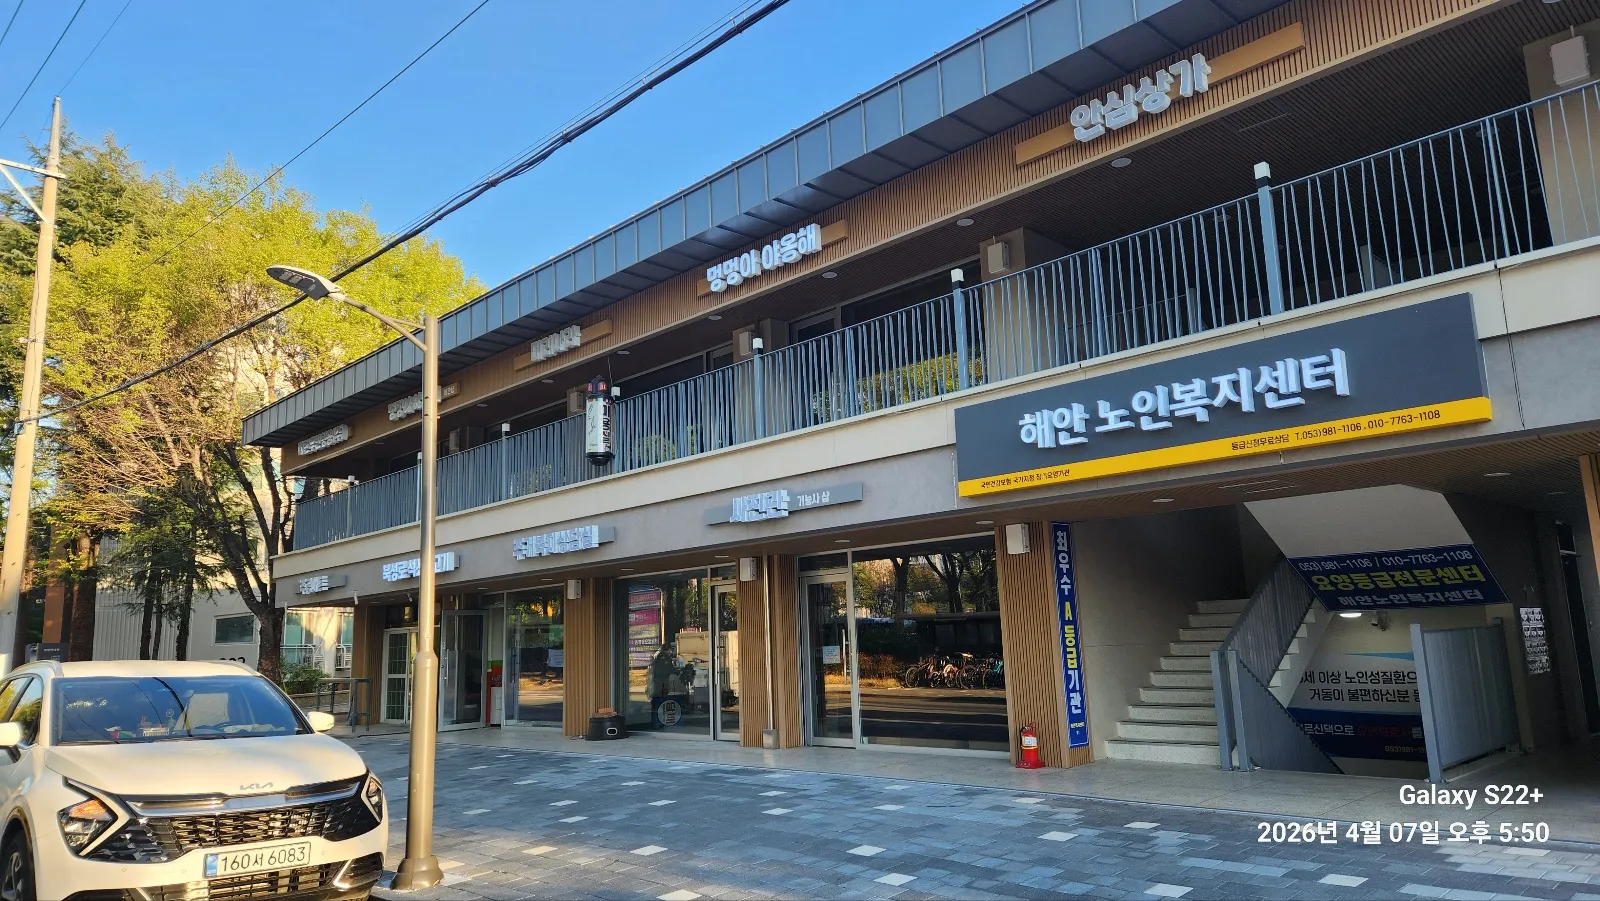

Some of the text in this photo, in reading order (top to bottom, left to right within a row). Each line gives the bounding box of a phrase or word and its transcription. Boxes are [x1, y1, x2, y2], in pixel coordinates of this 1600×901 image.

[1070, 52, 1211, 142] 안심상가
[706, 223, 822, 293] 멍멍아 야옹해
[1018, 348, 1350, 449] 해안 노인복지센터
[1231, 433, 1290, 450] 등급신청무료상담
[1367, 410, 1440, 430] 010-7763-1108
[1013, 474, 1035, 484] 국가지정
[797, 492, 820, 507] 기능사
[1056, 530, 1072, 596] 최우수
[1383, 550, 1473, 567] 010-7763-1108
[1311, 564, 1487, 591] 요양등급전문센터
[1338, 589, 1484, 606] 해안노인복지센터
[1299, 671, 1315, 684] 세
[1318, 671, 1341, 684] 이상
[1309, 688, 1344, 702] 거동이
[1347, 689, 1409, 703] 불편하신분
[1301, 723, 1355, 736] 르신댁으로
[239, 782, 273, 790] KIA
[221, 846, 306, 872] 160서 6083
